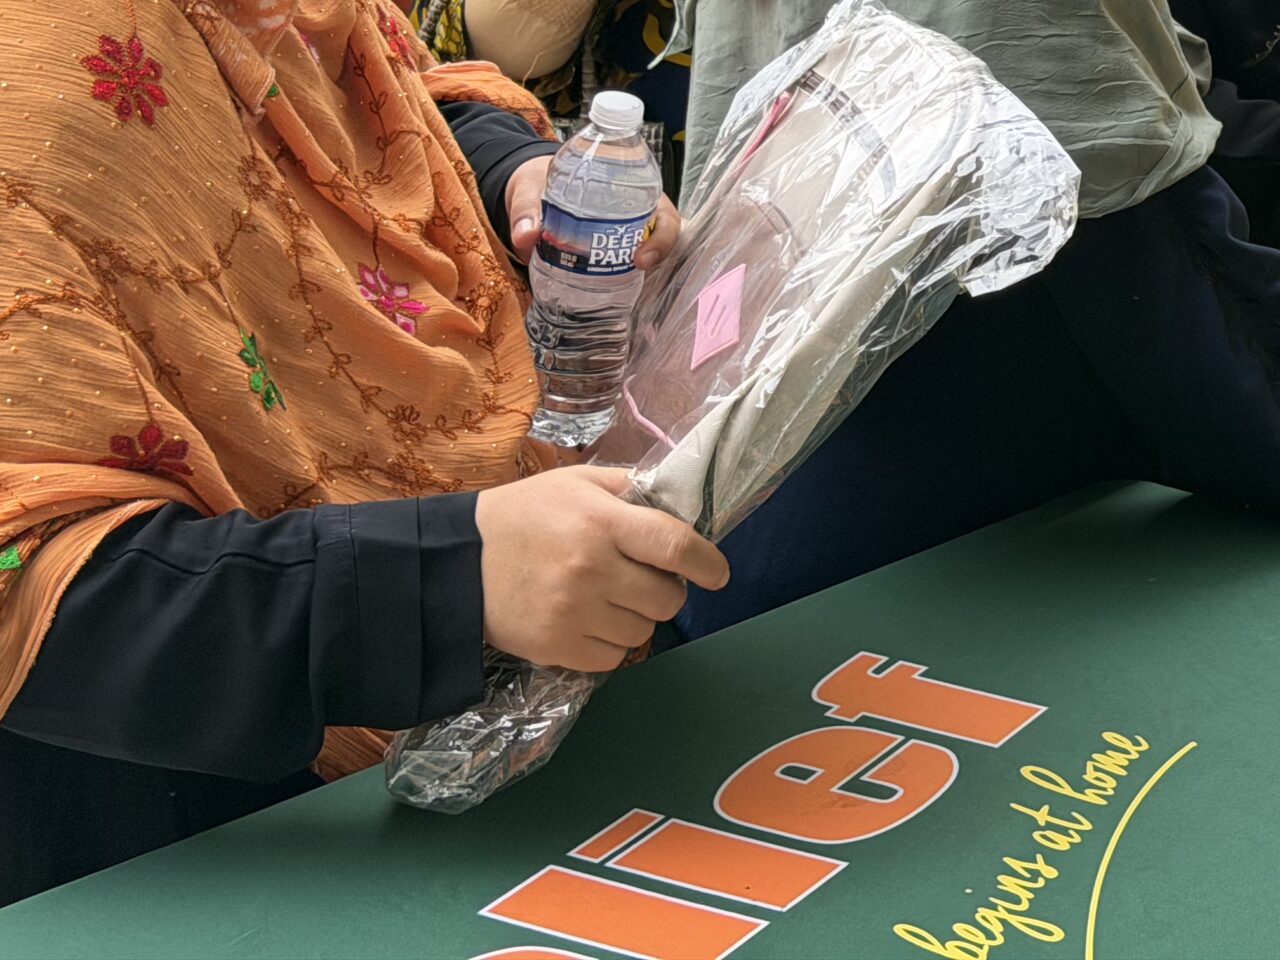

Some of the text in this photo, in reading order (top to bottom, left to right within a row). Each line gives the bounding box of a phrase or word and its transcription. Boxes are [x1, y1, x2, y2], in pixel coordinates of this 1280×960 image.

[591, 229, 643, 248] DEER
[466, 651, 1048, 960] lief
[893, 731, 1149, 960] begins at home
